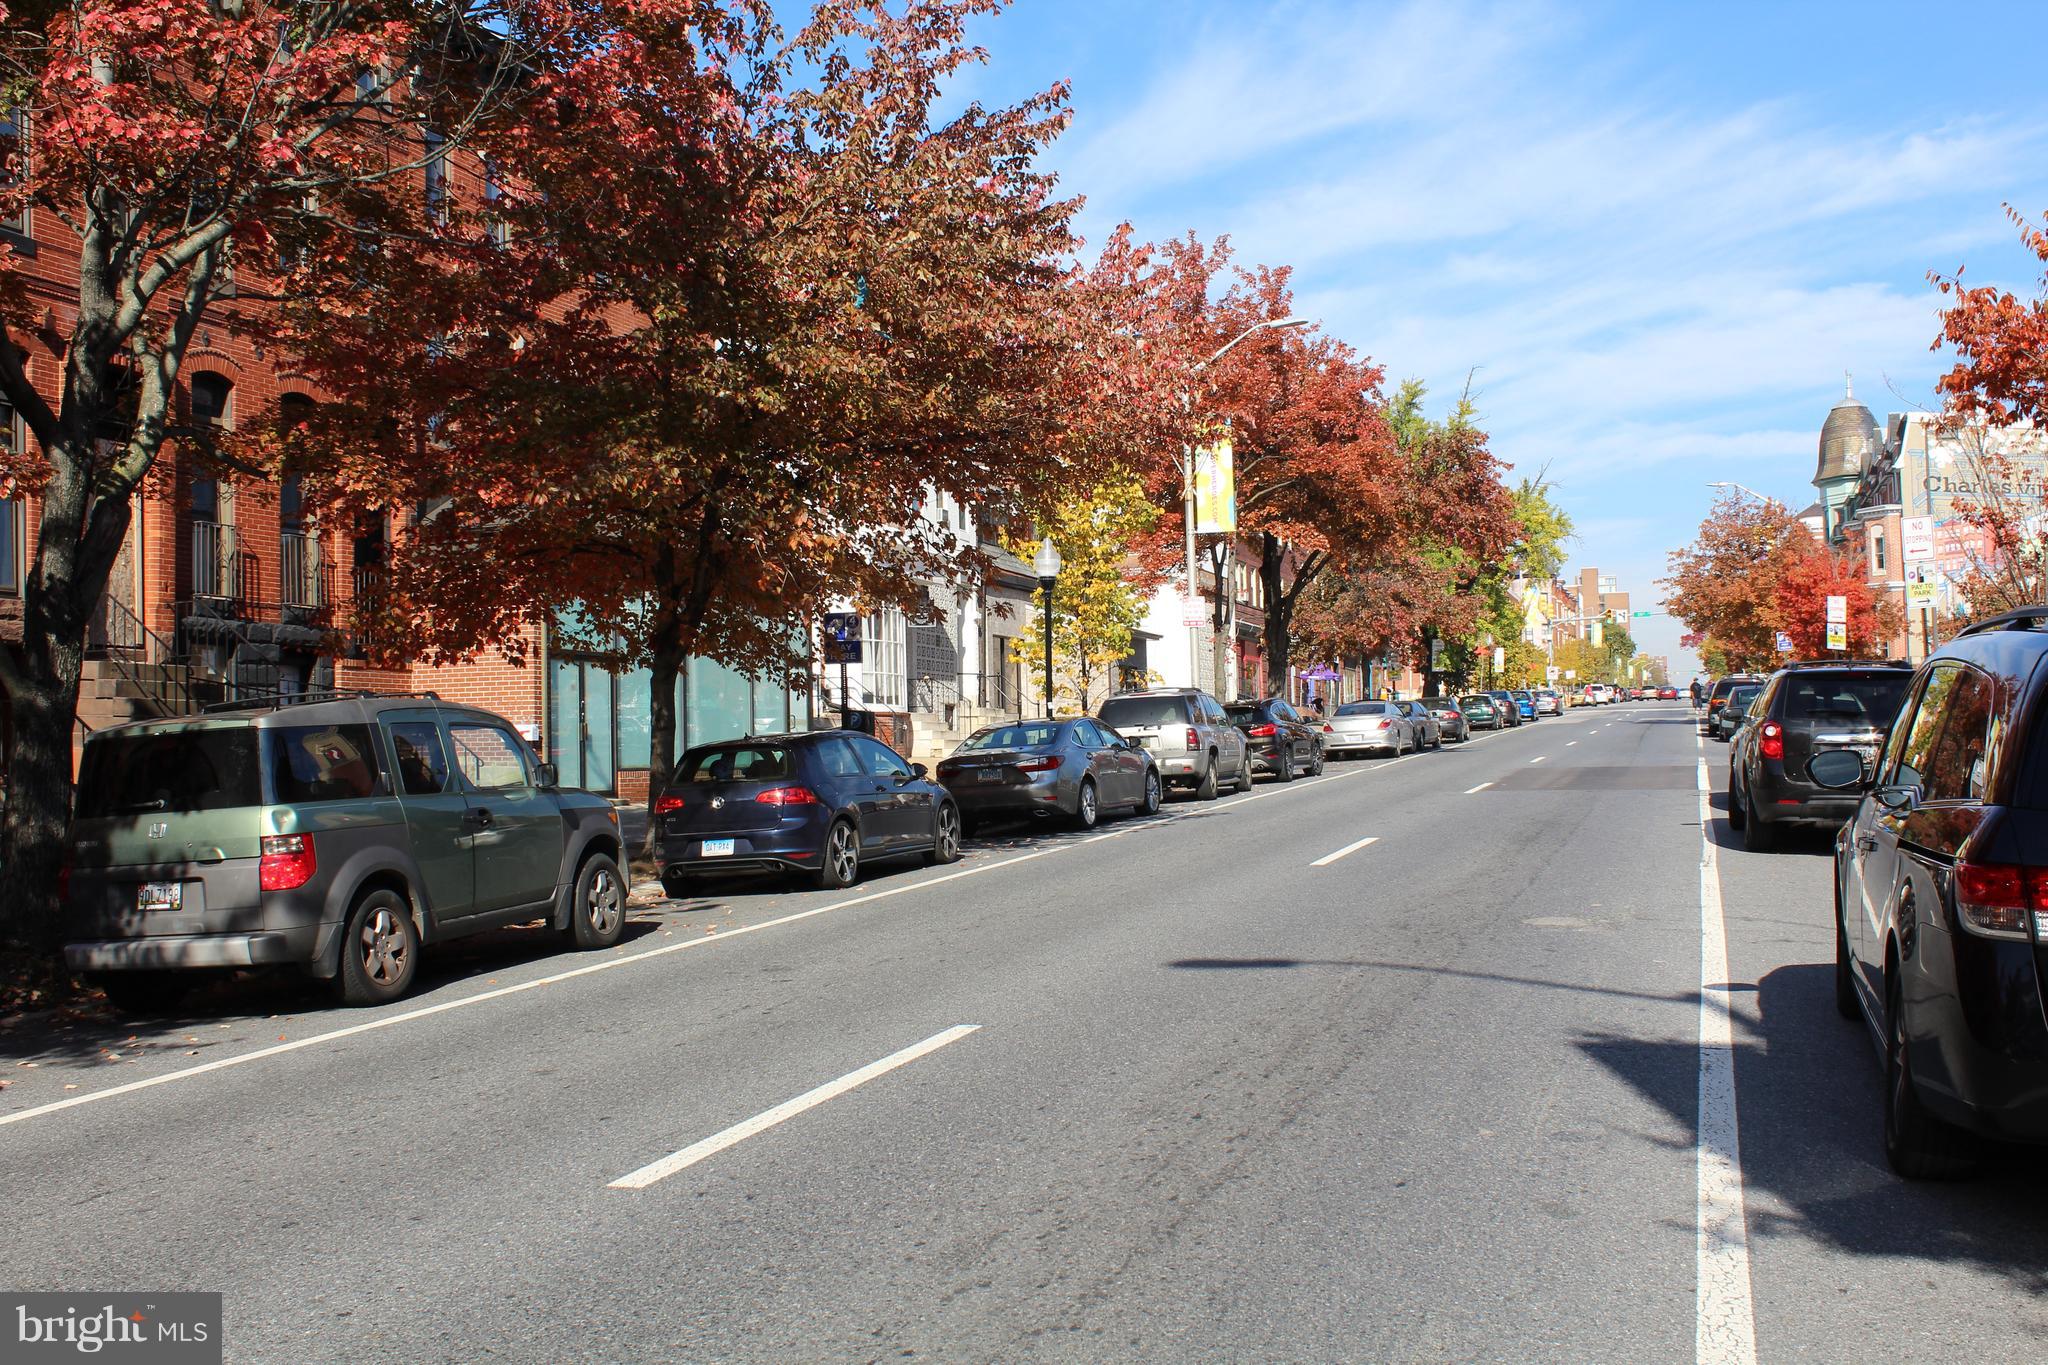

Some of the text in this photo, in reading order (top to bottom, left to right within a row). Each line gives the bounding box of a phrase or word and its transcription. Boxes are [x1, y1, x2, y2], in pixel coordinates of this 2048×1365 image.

[1911, 520, 1923, 530] NO
[1913, 589, 1932, 597] PARK
[830, 652, 857, 661] HRE
